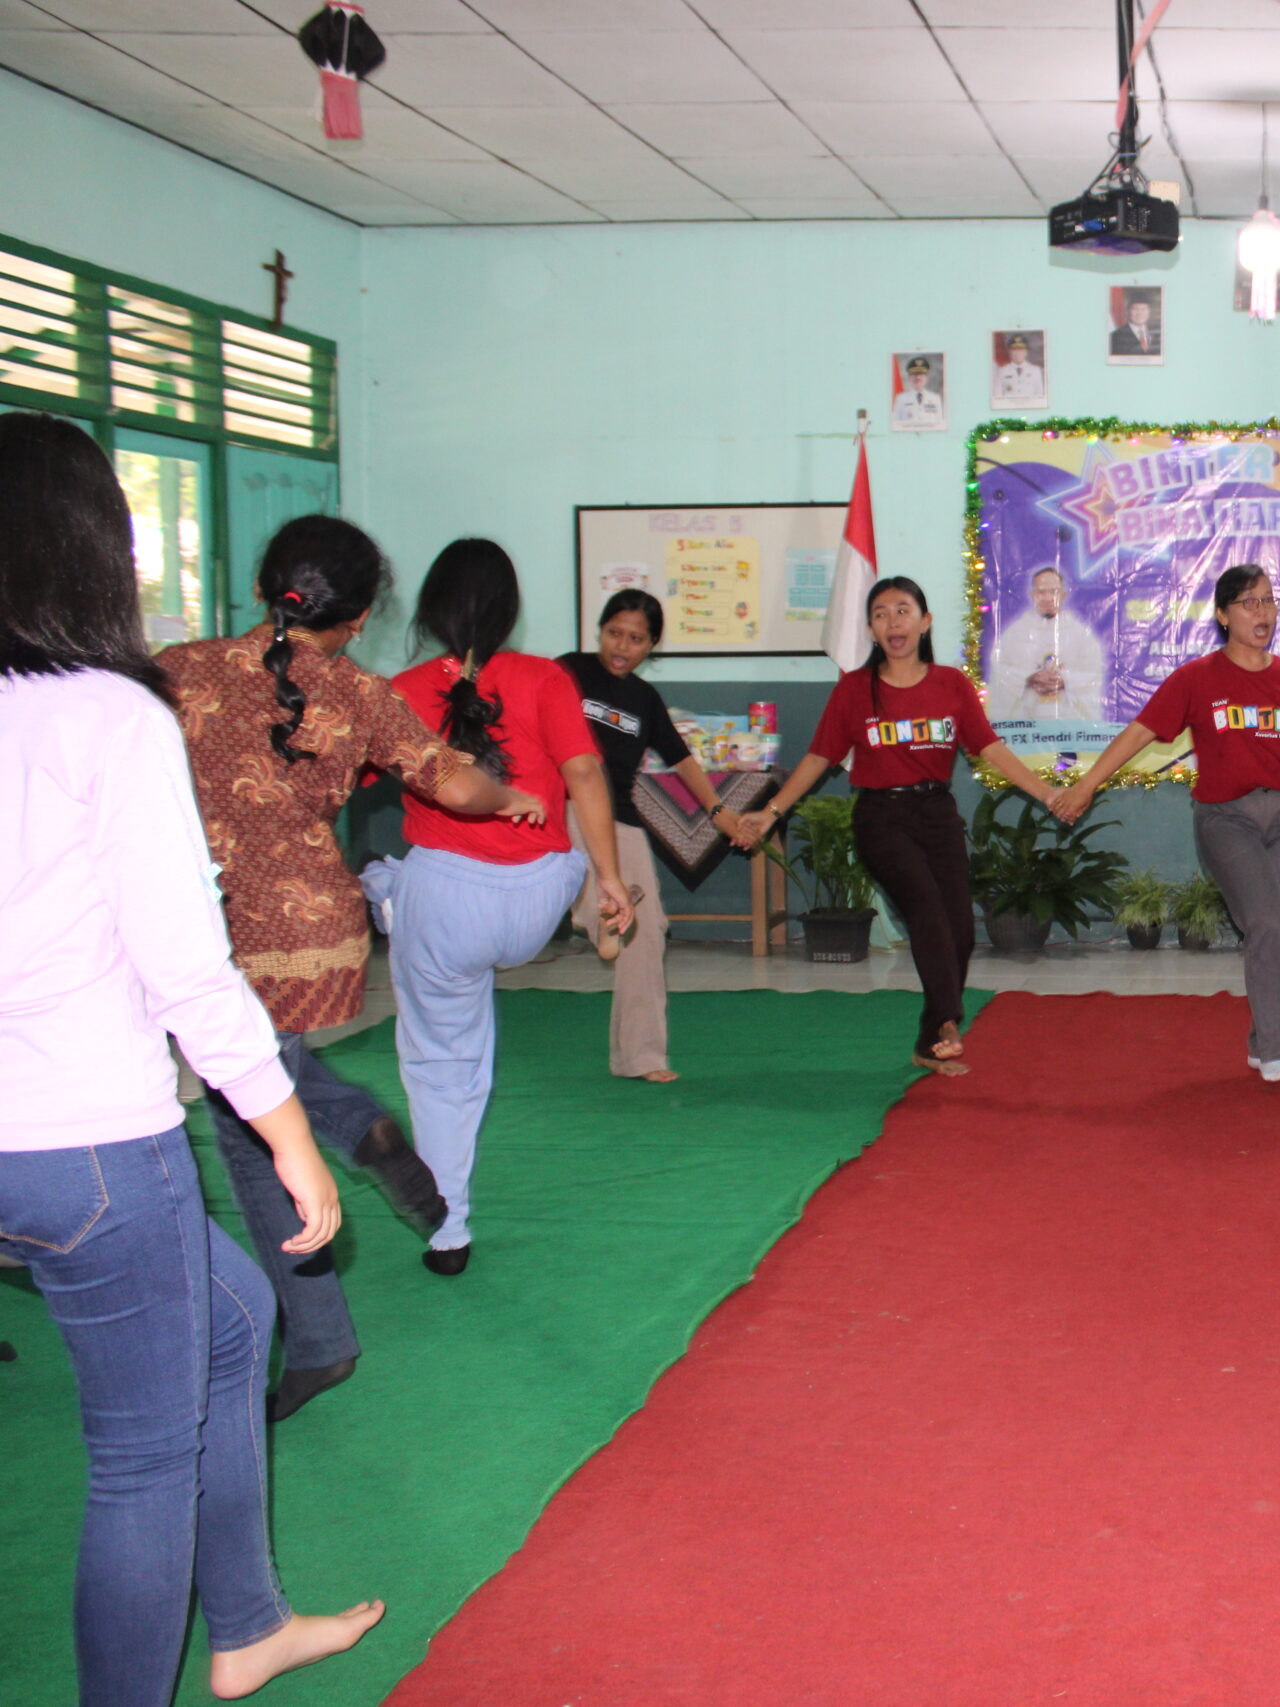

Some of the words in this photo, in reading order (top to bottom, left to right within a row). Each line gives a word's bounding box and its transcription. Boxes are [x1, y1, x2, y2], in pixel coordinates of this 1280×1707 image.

[1105, 445, 1273, 499] BINTER
[866, 717, 954, 748] BINTER
[990, 720, 1037, 730] ersama:
[1011, 733, 1028, 745] FX
[1031, 731, 1072, 743] Hendri
